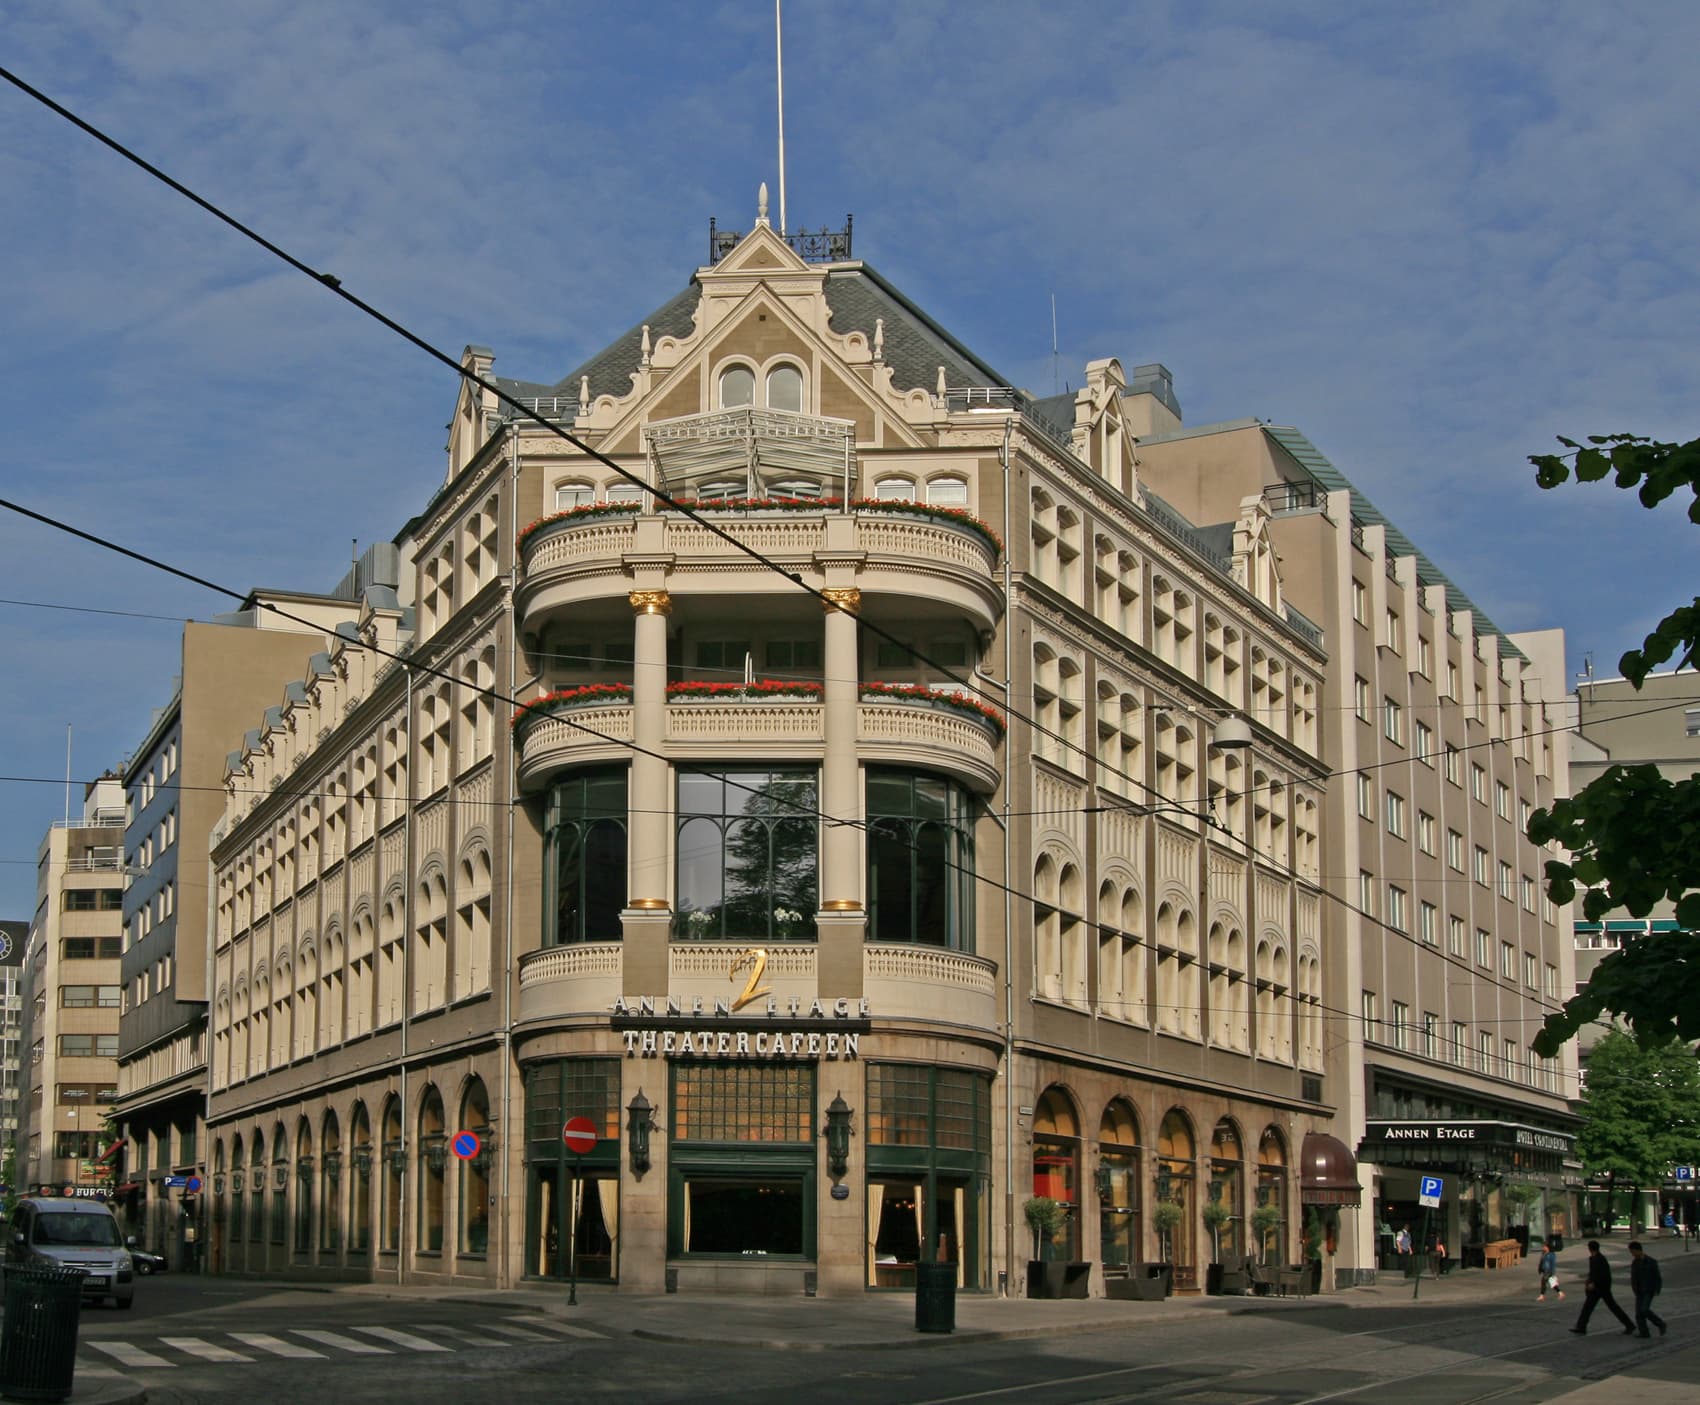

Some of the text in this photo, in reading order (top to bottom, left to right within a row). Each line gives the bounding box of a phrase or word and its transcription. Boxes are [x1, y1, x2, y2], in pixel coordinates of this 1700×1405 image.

[729, 948, 773, 1012] 2
[611, 995, 871, 1018] ANNEN ETAGE
[623, 1030, 860, 1055] THEATERCAFEEN
[1680, 1168, 1687, 1179] P
[1426, 1180, 1437, 1194] P
